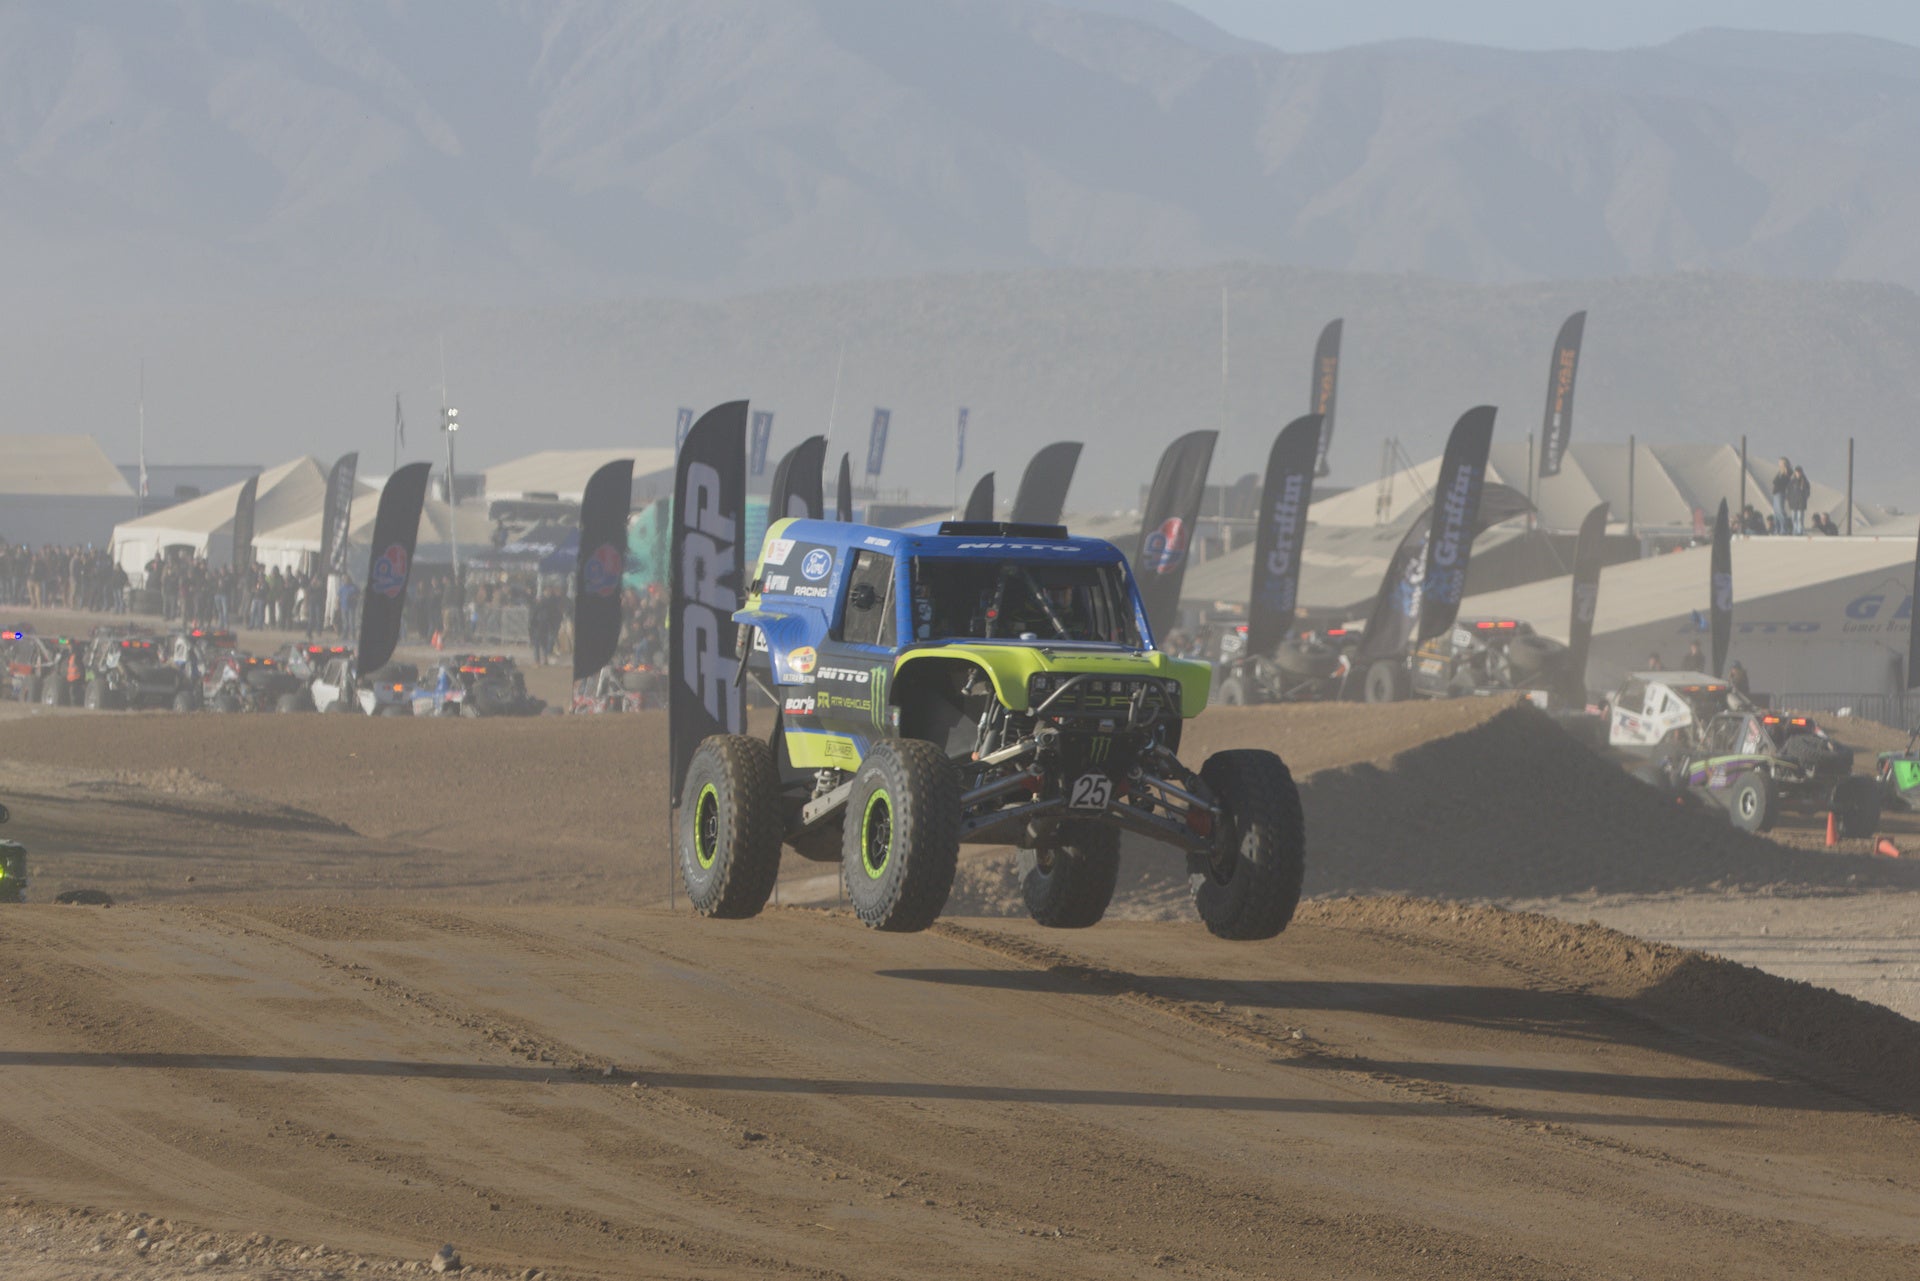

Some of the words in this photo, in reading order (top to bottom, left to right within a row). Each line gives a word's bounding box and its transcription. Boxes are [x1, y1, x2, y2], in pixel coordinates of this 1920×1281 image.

[1266, 474, 1304, 575] Griffin
[1434, 464, 1473, 566] Griffin
[957, 542, 1081, 553] NITTO
[793, 586, 828, 598] RACING
[817, 666, 869, 684] NITTO
[1073, 776, 1106, 807] 25
